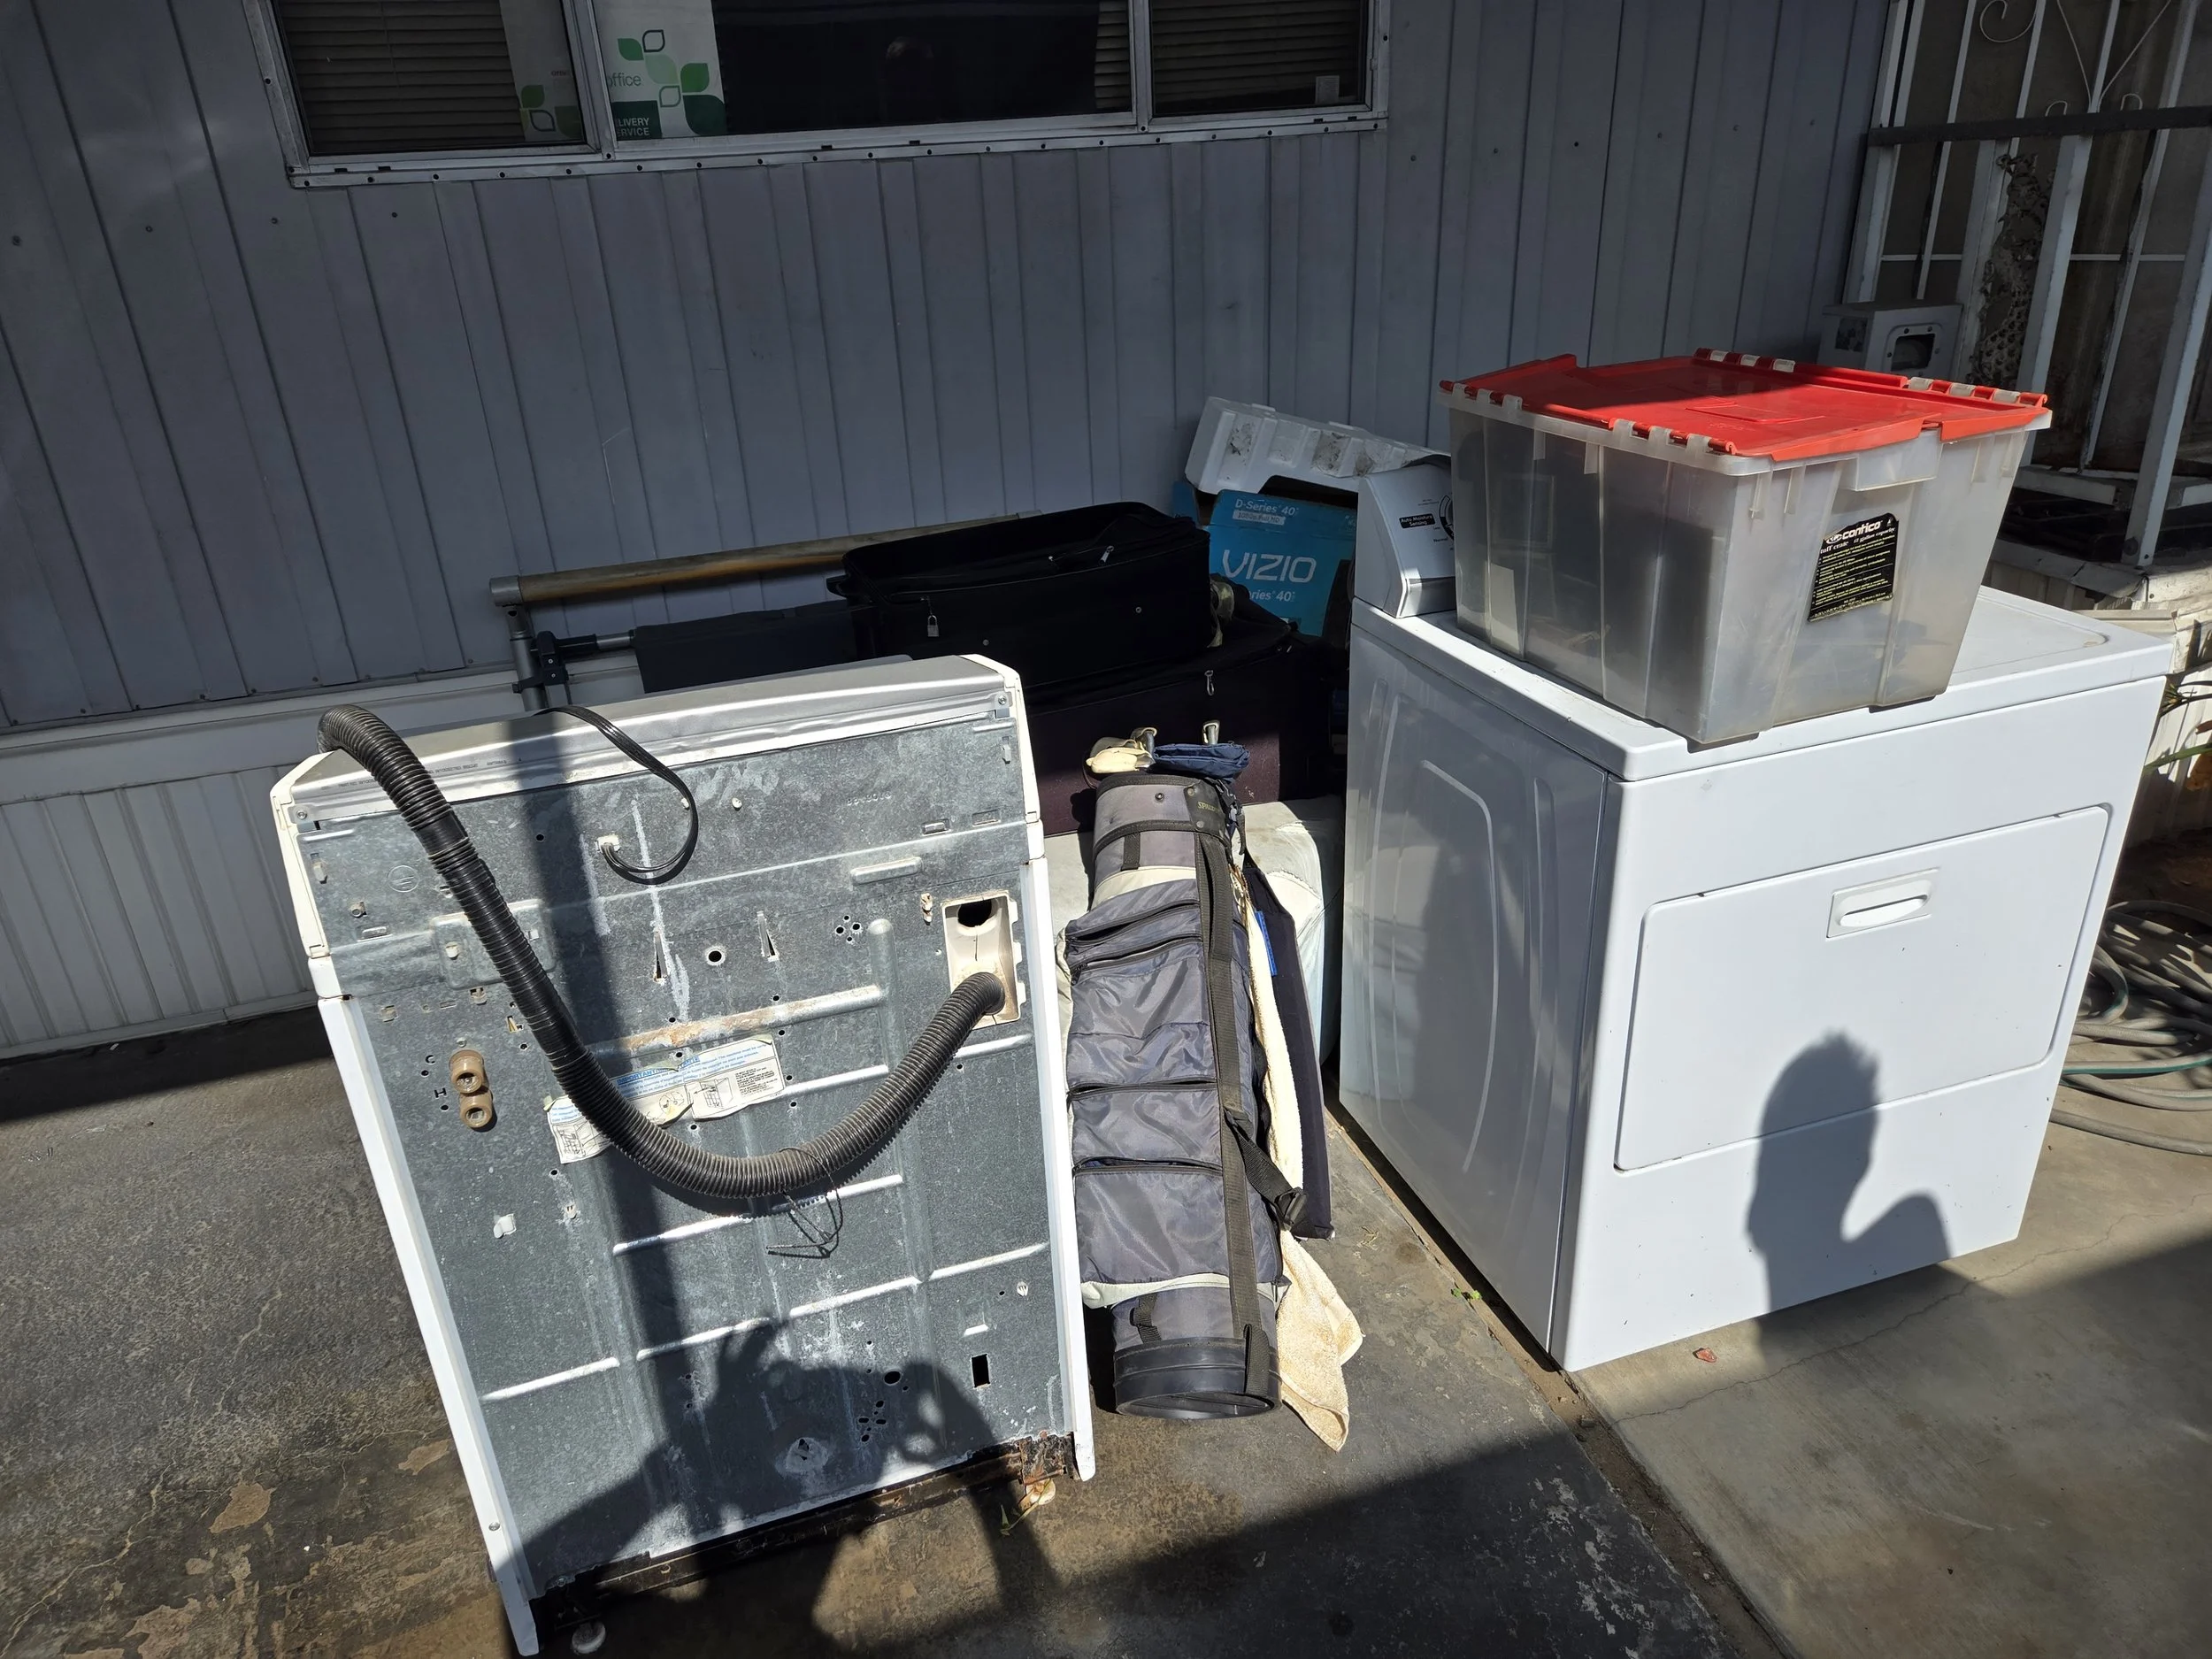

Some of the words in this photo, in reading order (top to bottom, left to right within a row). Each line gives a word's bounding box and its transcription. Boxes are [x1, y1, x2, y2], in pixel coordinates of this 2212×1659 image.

[1842, 521, 1881, 540] contico
[1223, 549, 1317, 583] VIZIO
[426, 1055, 435, 1064] C
[434, 1087, 447, 1098] H
